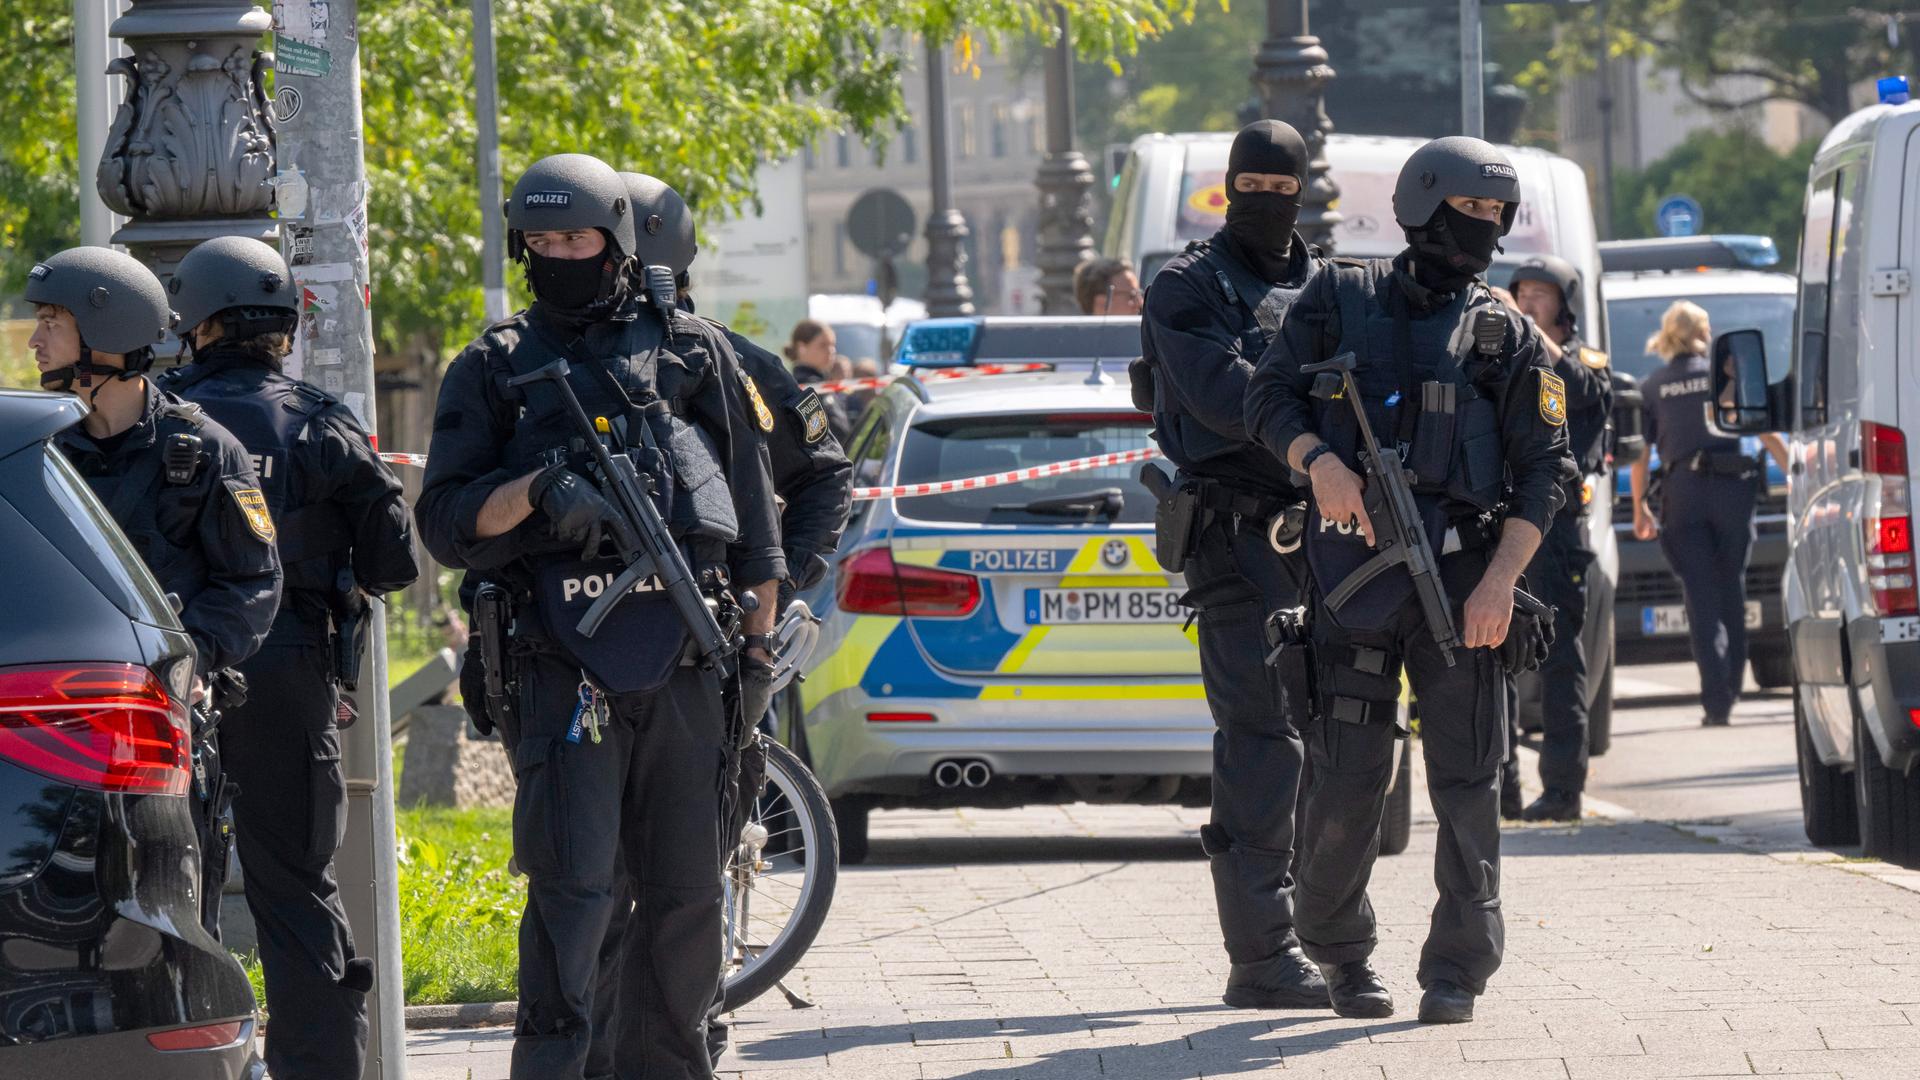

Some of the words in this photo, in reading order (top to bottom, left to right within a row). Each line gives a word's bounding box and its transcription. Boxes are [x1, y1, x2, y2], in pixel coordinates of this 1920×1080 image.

[526, 194, 568, 204] POLIZEI
[1660, 377, 1709, 400] POLIZE
[801, 398, 819, 416] POLIZEI
[970, 551, 1056, 570] POLIZEI
[1045, 593, 1063, 620] M
[1085, 593, 1121, 619] PM
